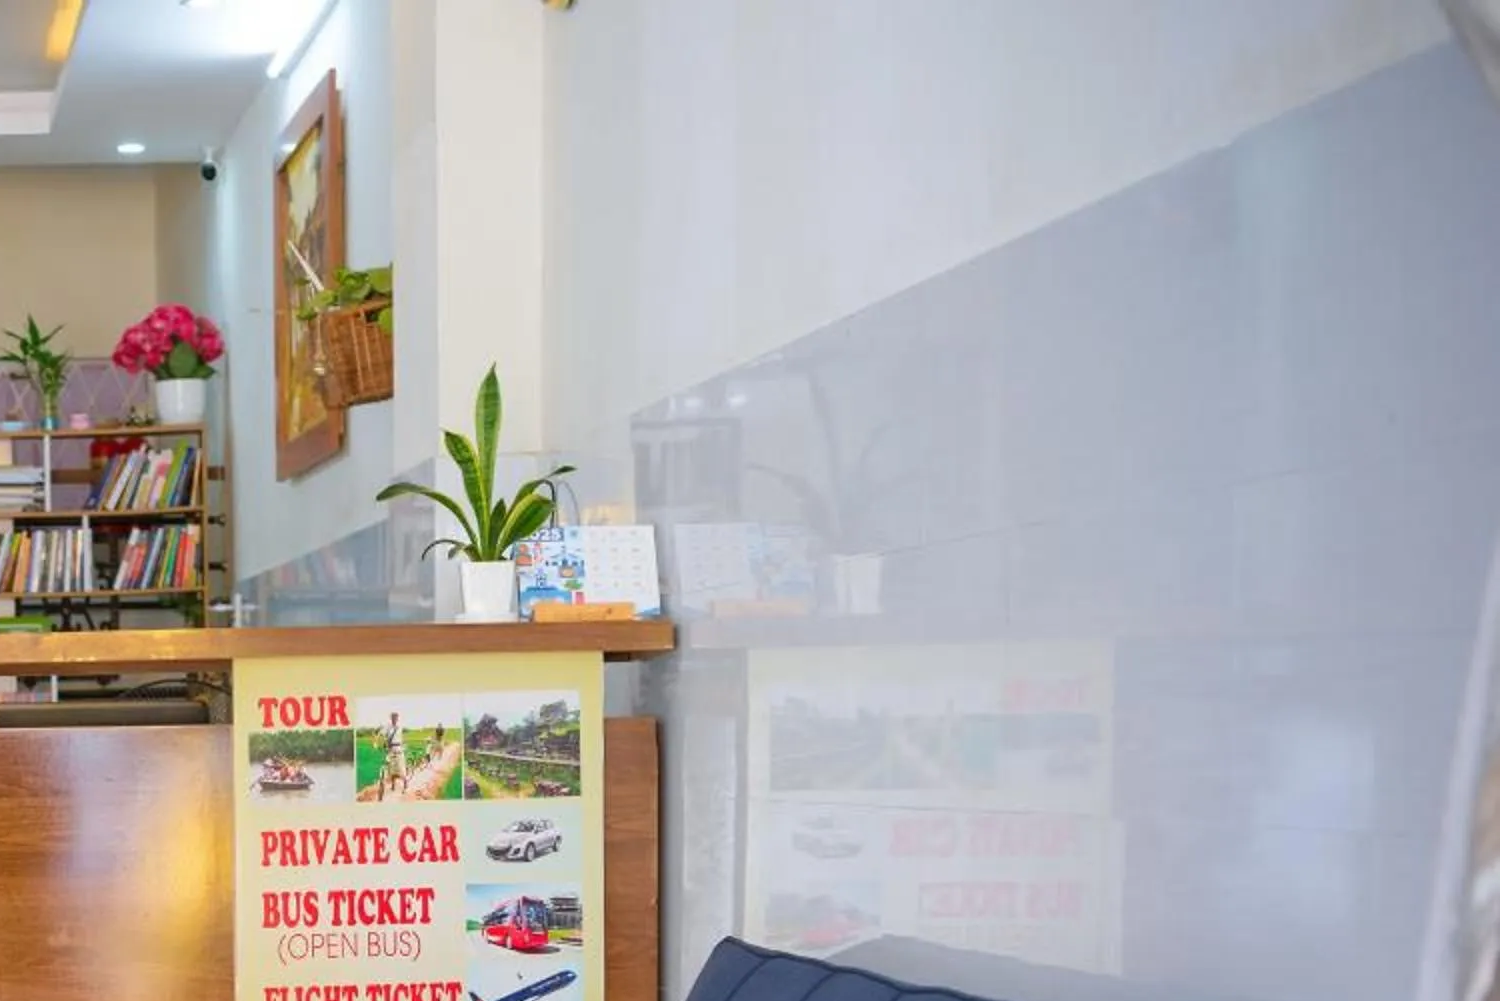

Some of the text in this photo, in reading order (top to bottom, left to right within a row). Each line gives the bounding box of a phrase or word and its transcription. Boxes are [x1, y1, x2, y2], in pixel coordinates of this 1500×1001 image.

[259, 694, 350, 728] TOUR
[261, 825, 460, 867] PRIVATE CAR
[262, 888, 435, 928] BUS TICKET
[278, 930, 422, 966] (OPEN BUS)
